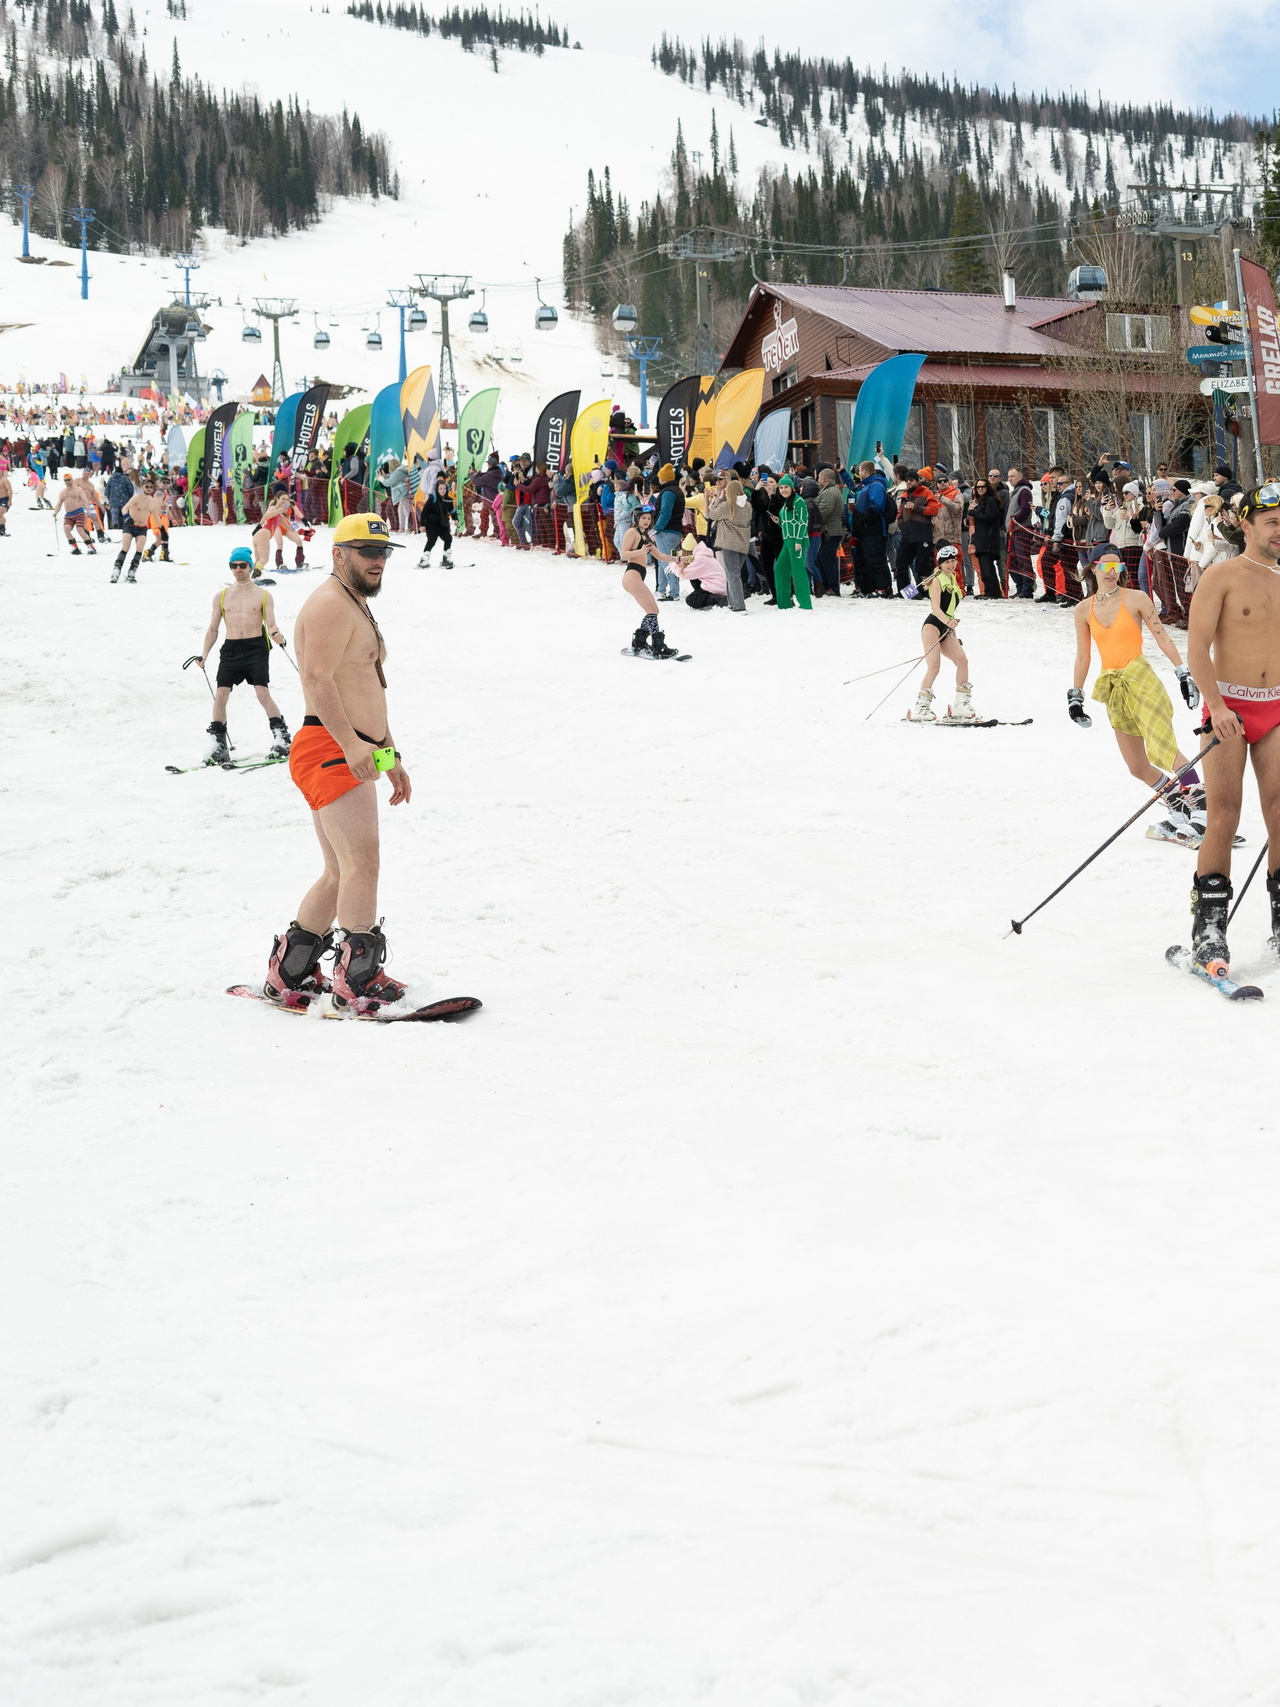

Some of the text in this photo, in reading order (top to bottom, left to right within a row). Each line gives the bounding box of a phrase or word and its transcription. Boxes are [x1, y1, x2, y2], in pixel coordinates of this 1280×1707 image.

[1181, 252, 1193, 261] 13
[1192, 350, 1228, 360] Mammoth
[212, 420, 223, 456] HOTELS
[298, 403, 317, 454] HOTELS
[546, 417, 563, 473] HOTELS
[669, 407, 685, 470] HOTELS
[1227, 684, 1266, 699] Calvin
